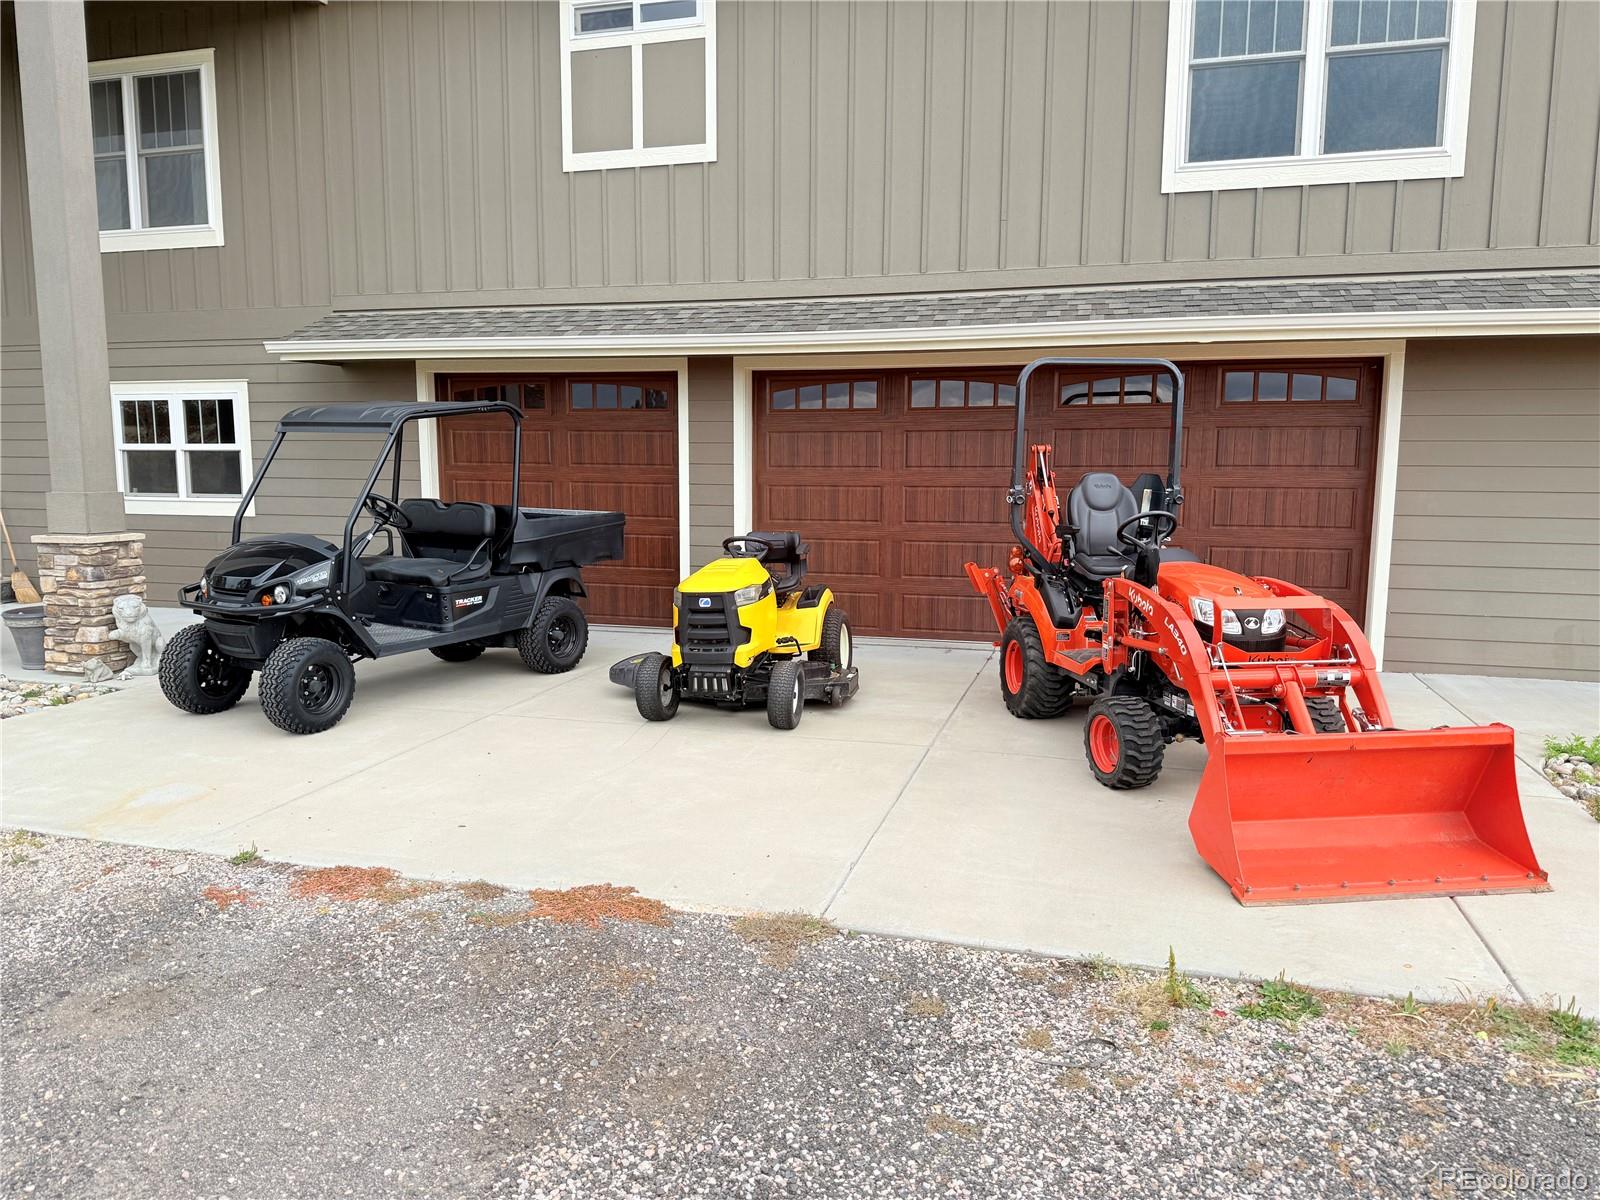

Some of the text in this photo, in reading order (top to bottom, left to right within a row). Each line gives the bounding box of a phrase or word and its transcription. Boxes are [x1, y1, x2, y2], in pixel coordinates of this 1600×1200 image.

[455, 595, 483, 605] TRACKER
[1128, 586, 1154, 616] Kubota
[1164, 616, 1187, 656] LA340
